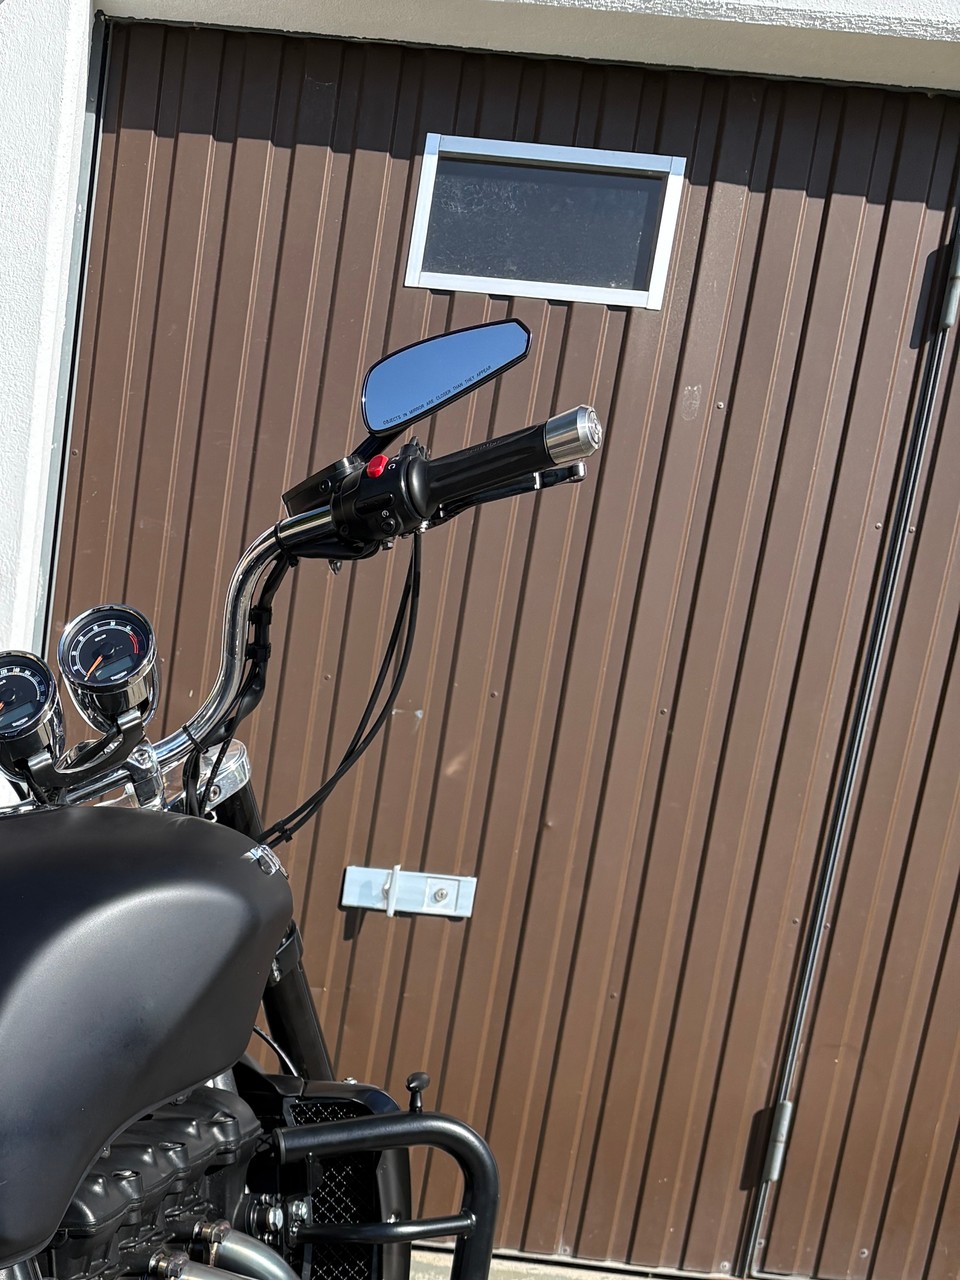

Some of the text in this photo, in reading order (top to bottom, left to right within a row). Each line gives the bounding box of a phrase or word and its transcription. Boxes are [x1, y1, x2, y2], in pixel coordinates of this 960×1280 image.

[383, 415, 401, 425] OBJECTS
[409, 404, 424, 415] MIRROR
[436, 389, 451, 401] CLOSER
[465, 376, 475, 384] THEY
[476, 365, 491, 377] APPEAR
